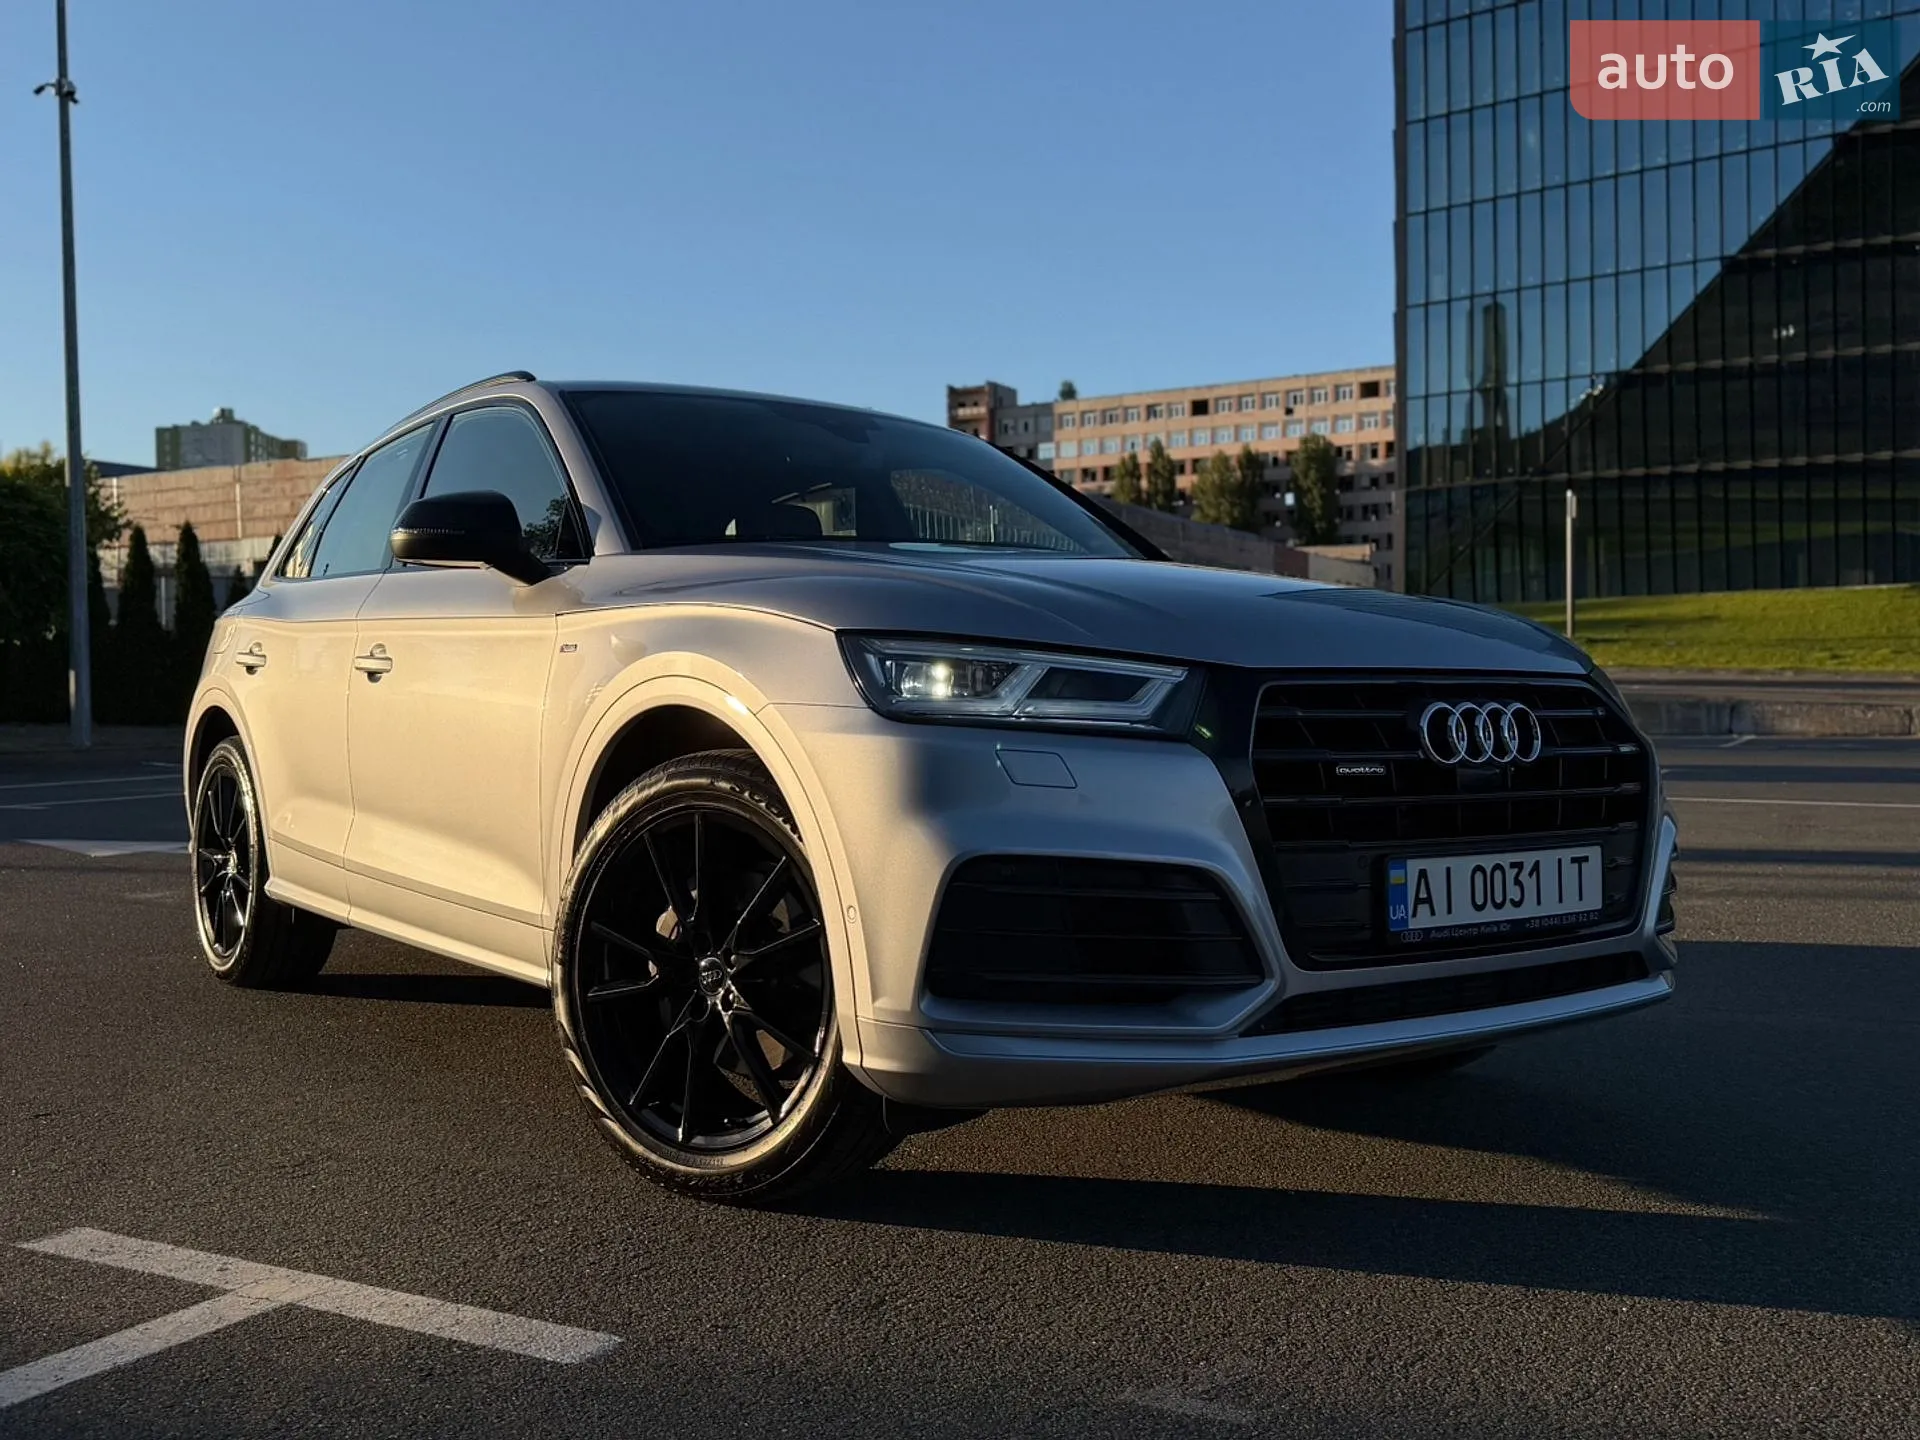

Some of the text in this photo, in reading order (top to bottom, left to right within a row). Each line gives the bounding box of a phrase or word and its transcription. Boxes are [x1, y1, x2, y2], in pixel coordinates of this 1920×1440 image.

[1411, 855, 1590, 918] AI 0031 IT
[1389, 905, 1408, 920] UA
